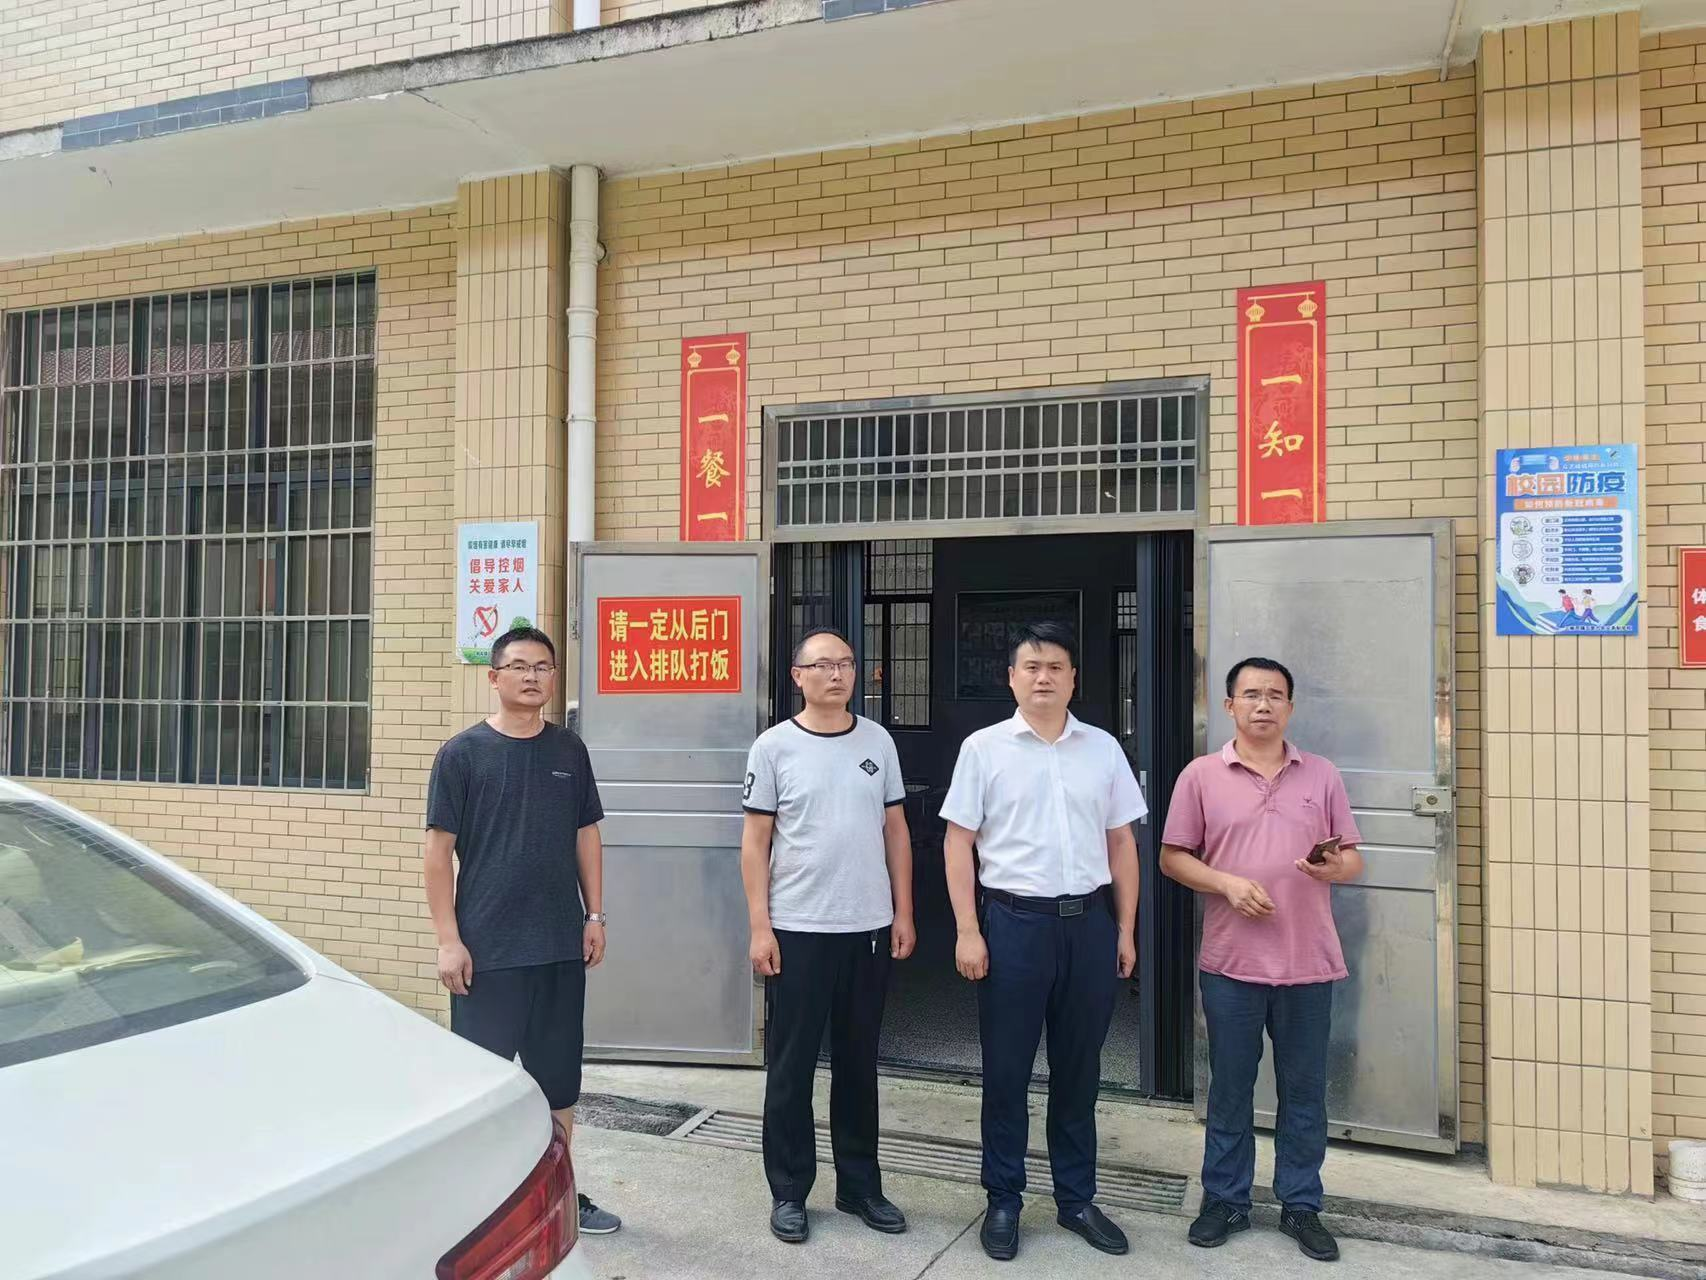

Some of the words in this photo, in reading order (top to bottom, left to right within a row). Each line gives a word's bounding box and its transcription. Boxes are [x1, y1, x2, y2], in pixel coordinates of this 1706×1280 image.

[1258, 374, 1304, 500] 一知一
[696, 413, 731, 521] 一餐一
[1506, 472, 1625, 496] 校园防疫
[470, 557, 525, 574] 倡导控烟
[469, 577, 524, 594] 关爱家人
[609, 608, 728, 642] 请一定从后门
[609, 648, 729, 681] 进入排队打饭
